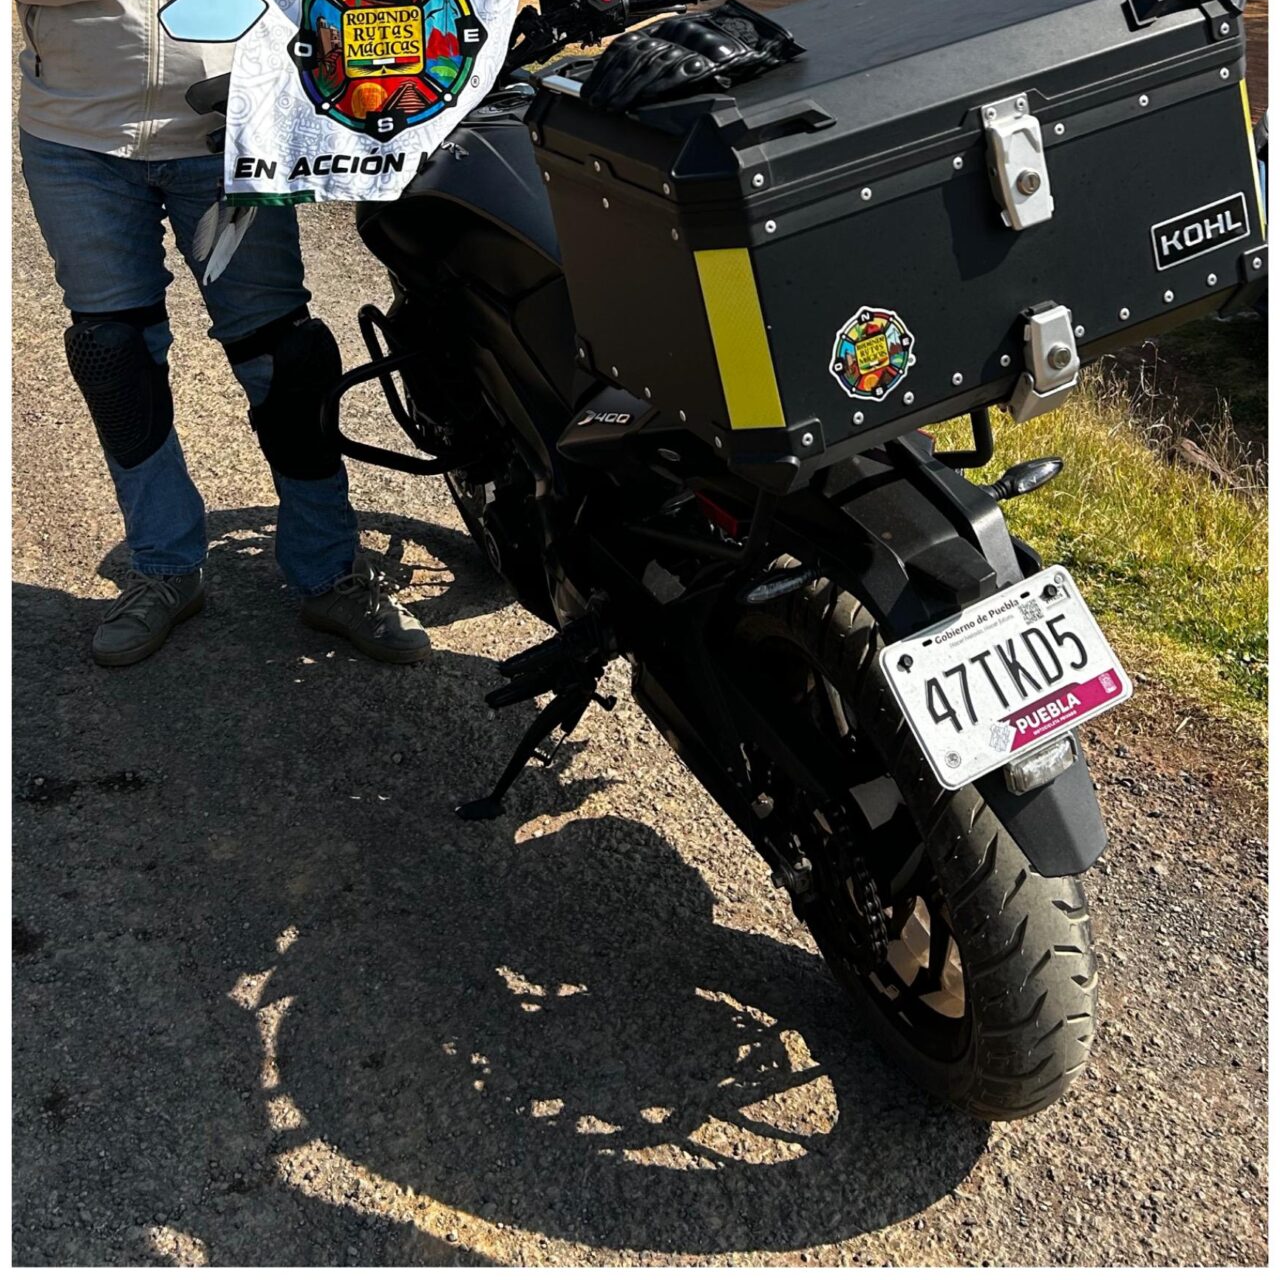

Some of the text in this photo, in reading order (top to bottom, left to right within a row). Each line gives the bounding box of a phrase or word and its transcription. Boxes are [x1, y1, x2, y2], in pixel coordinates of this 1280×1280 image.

[463, 28, 480, 43] E
[377, 117, 394, 133] S
[234, 157, 277, 180] EN
[288, 147, 405, 180] ACCIÓN
[1161, 211, 1242, 256] KOHL
[934, 621, 976, 645] Gobierno
[976, 614, 988, 625] de
[988, 600, 1020, 618] Puebla
[925, 614, 1087, 732] 47TKD5
[1016, 692, 1081, 734] PUEBLA
